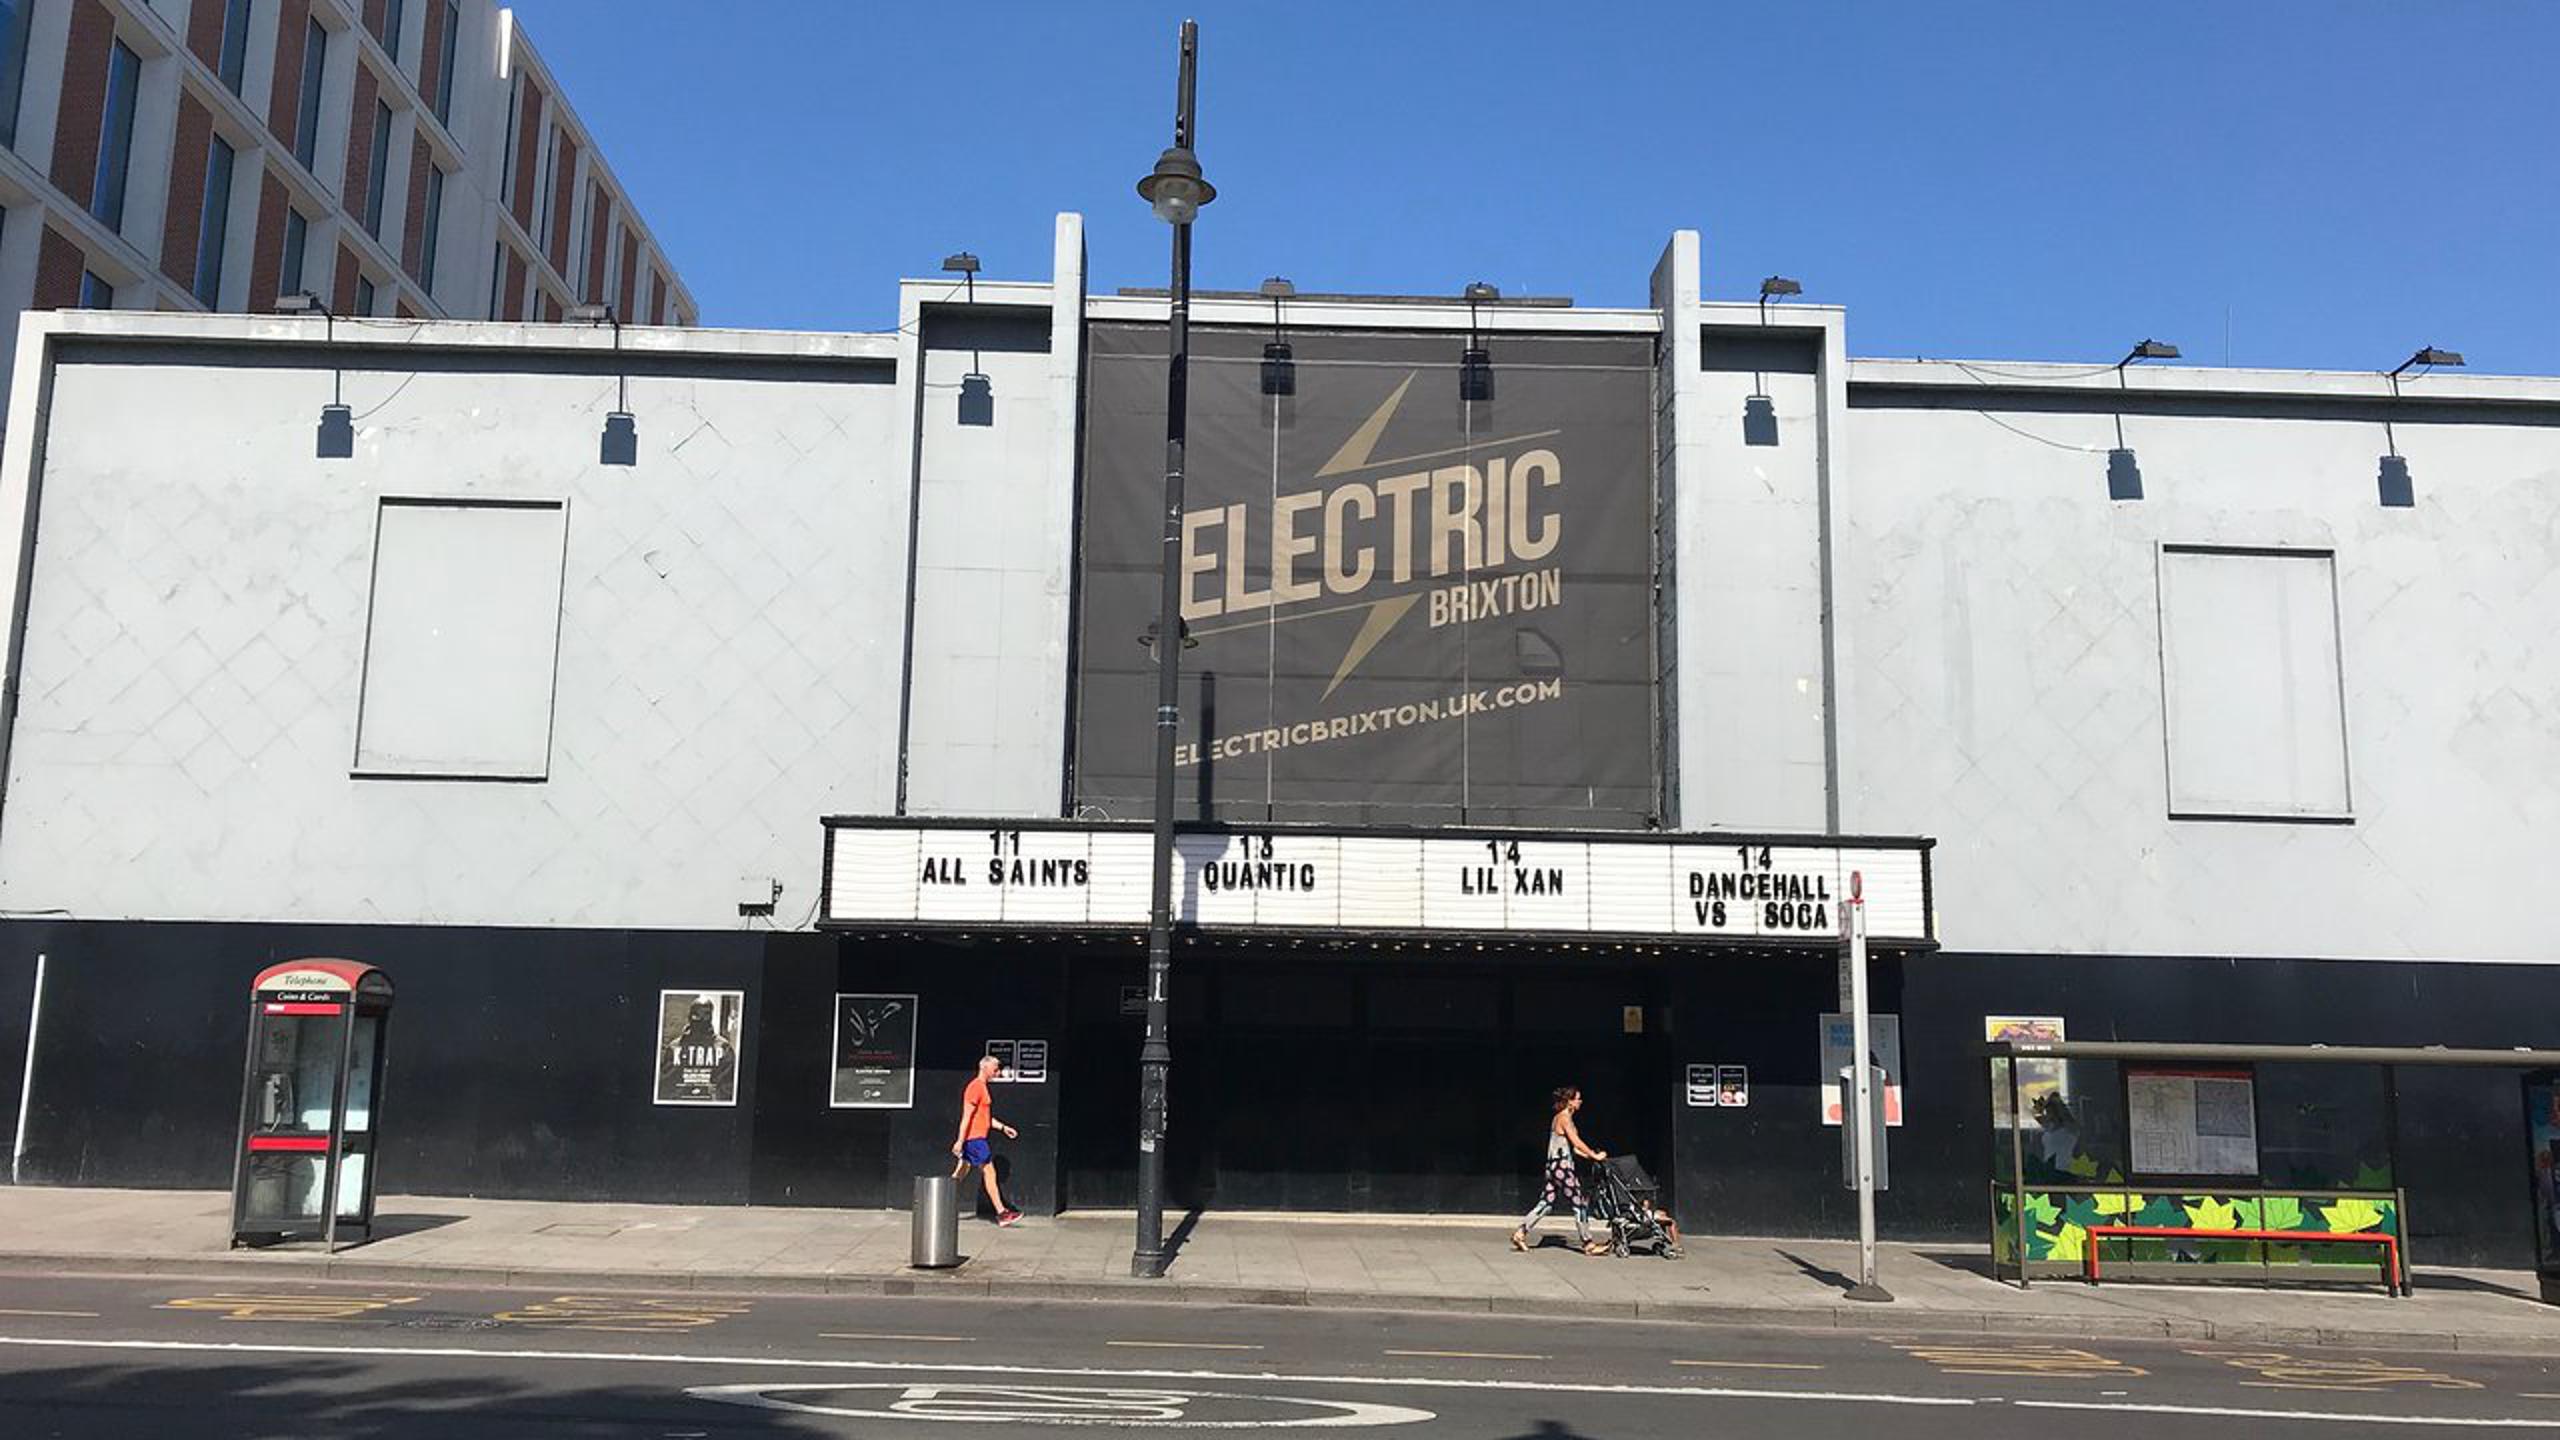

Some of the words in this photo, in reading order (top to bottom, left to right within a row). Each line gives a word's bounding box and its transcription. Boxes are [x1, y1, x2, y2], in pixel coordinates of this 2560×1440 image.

[1181, 449, 1561, 622] ELECTRIC
[1429, 568, 1561, 628] BRIXTON
[1174, 677, 1561, 768] ELECTRICBRIXTON.UK.COM
[990, 831, 1020, 856] 11
[1240, 836, 1273, 860] 13
[1487, 840, 1521, 866] 14
[1738, 845, 1772, 870] 14
[922, 857, 966, 885] ALL
[988, 858, 1088, 887] SAINTS
[1204, 861, 1315, 893] QUANTIC
[1462, 867, 1498, 895] LIL
[1514, 868, 1563, 896] XAN
[1689, 871, 1830, 901] DANCEHALL
[1695, 900, 1726, 927] VS
[1765, 901, 1828, 930] SOCA
[286, 975, 327, 986] Telephone
[673, 1046, 723, 1066] K-TRAP
